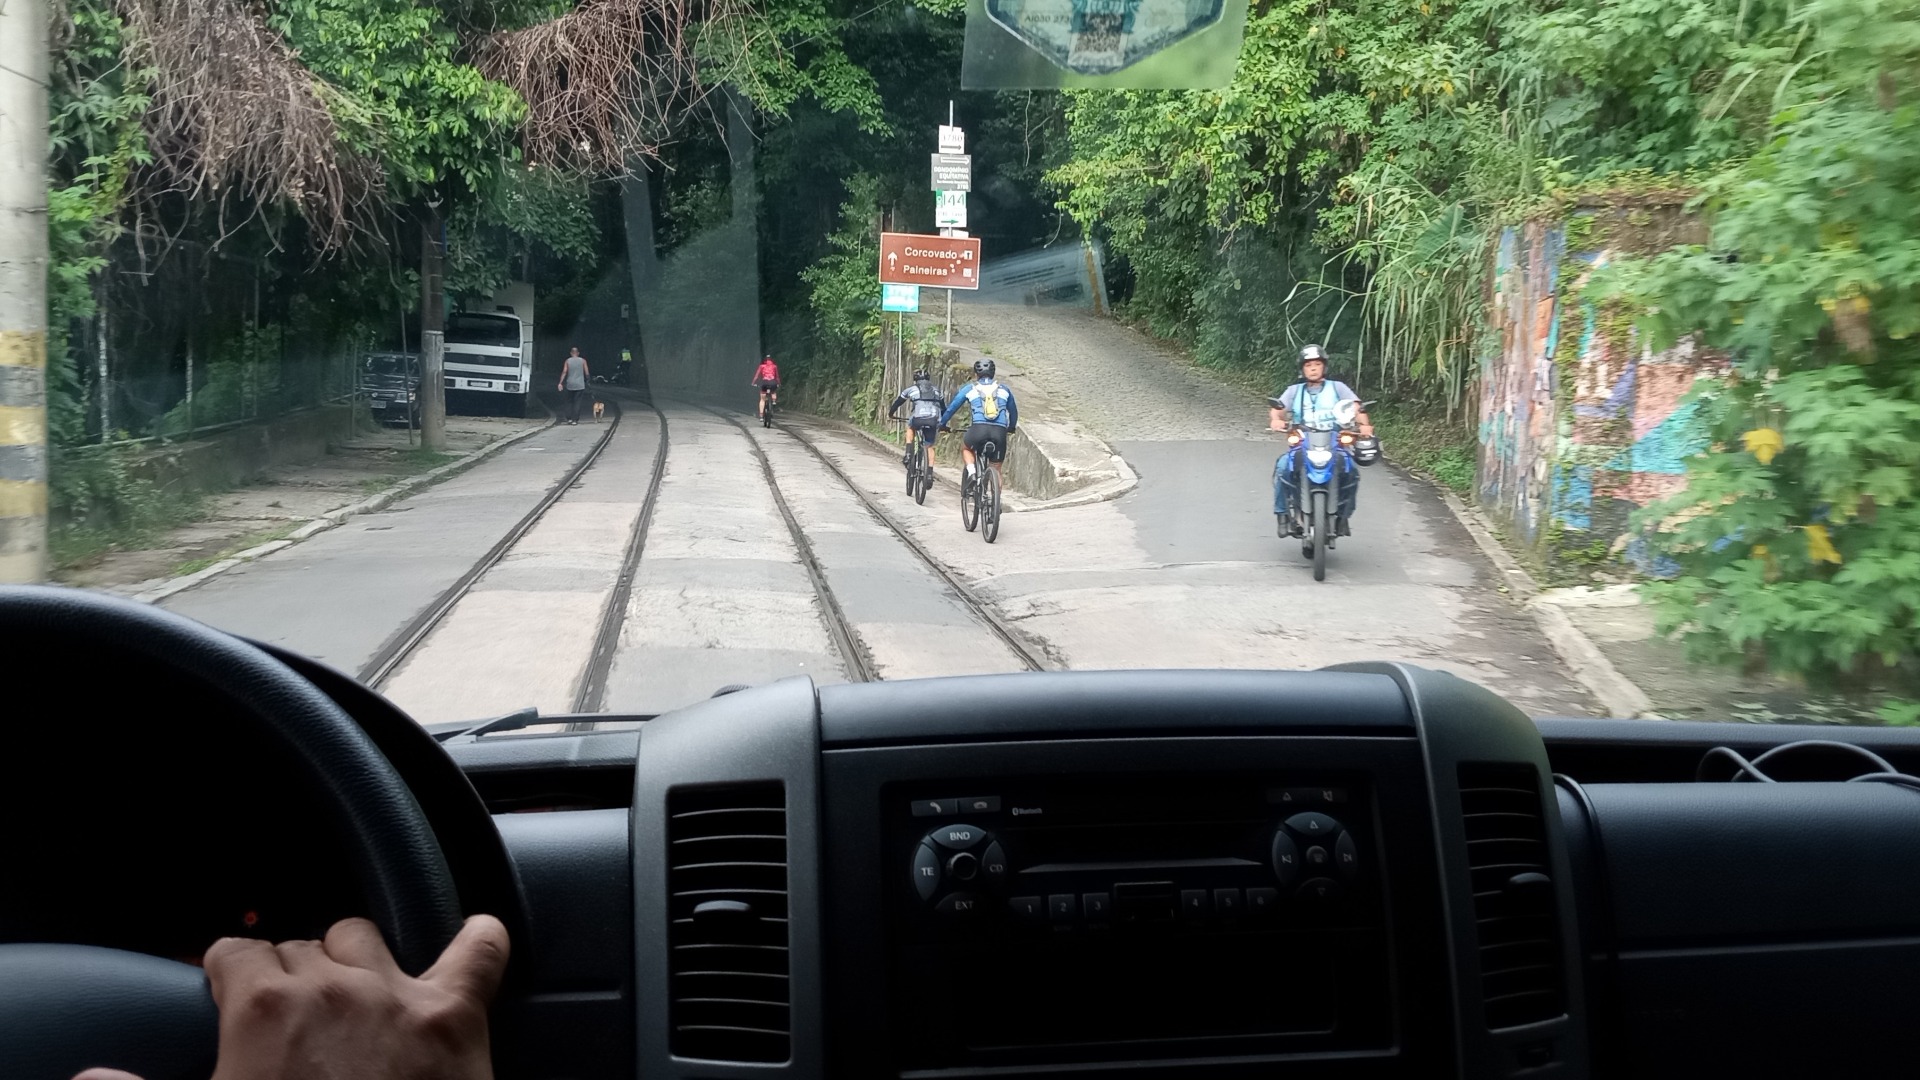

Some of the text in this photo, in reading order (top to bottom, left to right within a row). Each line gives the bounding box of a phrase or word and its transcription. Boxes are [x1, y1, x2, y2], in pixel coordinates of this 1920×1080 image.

[904, 247, 958, 260] Corcovado
[903, 264, 948, 276] Paineiras
[949, 831, 971, 841] BND
[921, 868, 935, 877] TE
[989, 864, 1003, 873] CD
[954, 900, 975, 910] EXT
[1095, 902, 1102, 911] 3
[1192, 898, 1199, 907] 4
[1225, 897, 1232, 907] 5
[1059, 903, 1067, 912] 2
